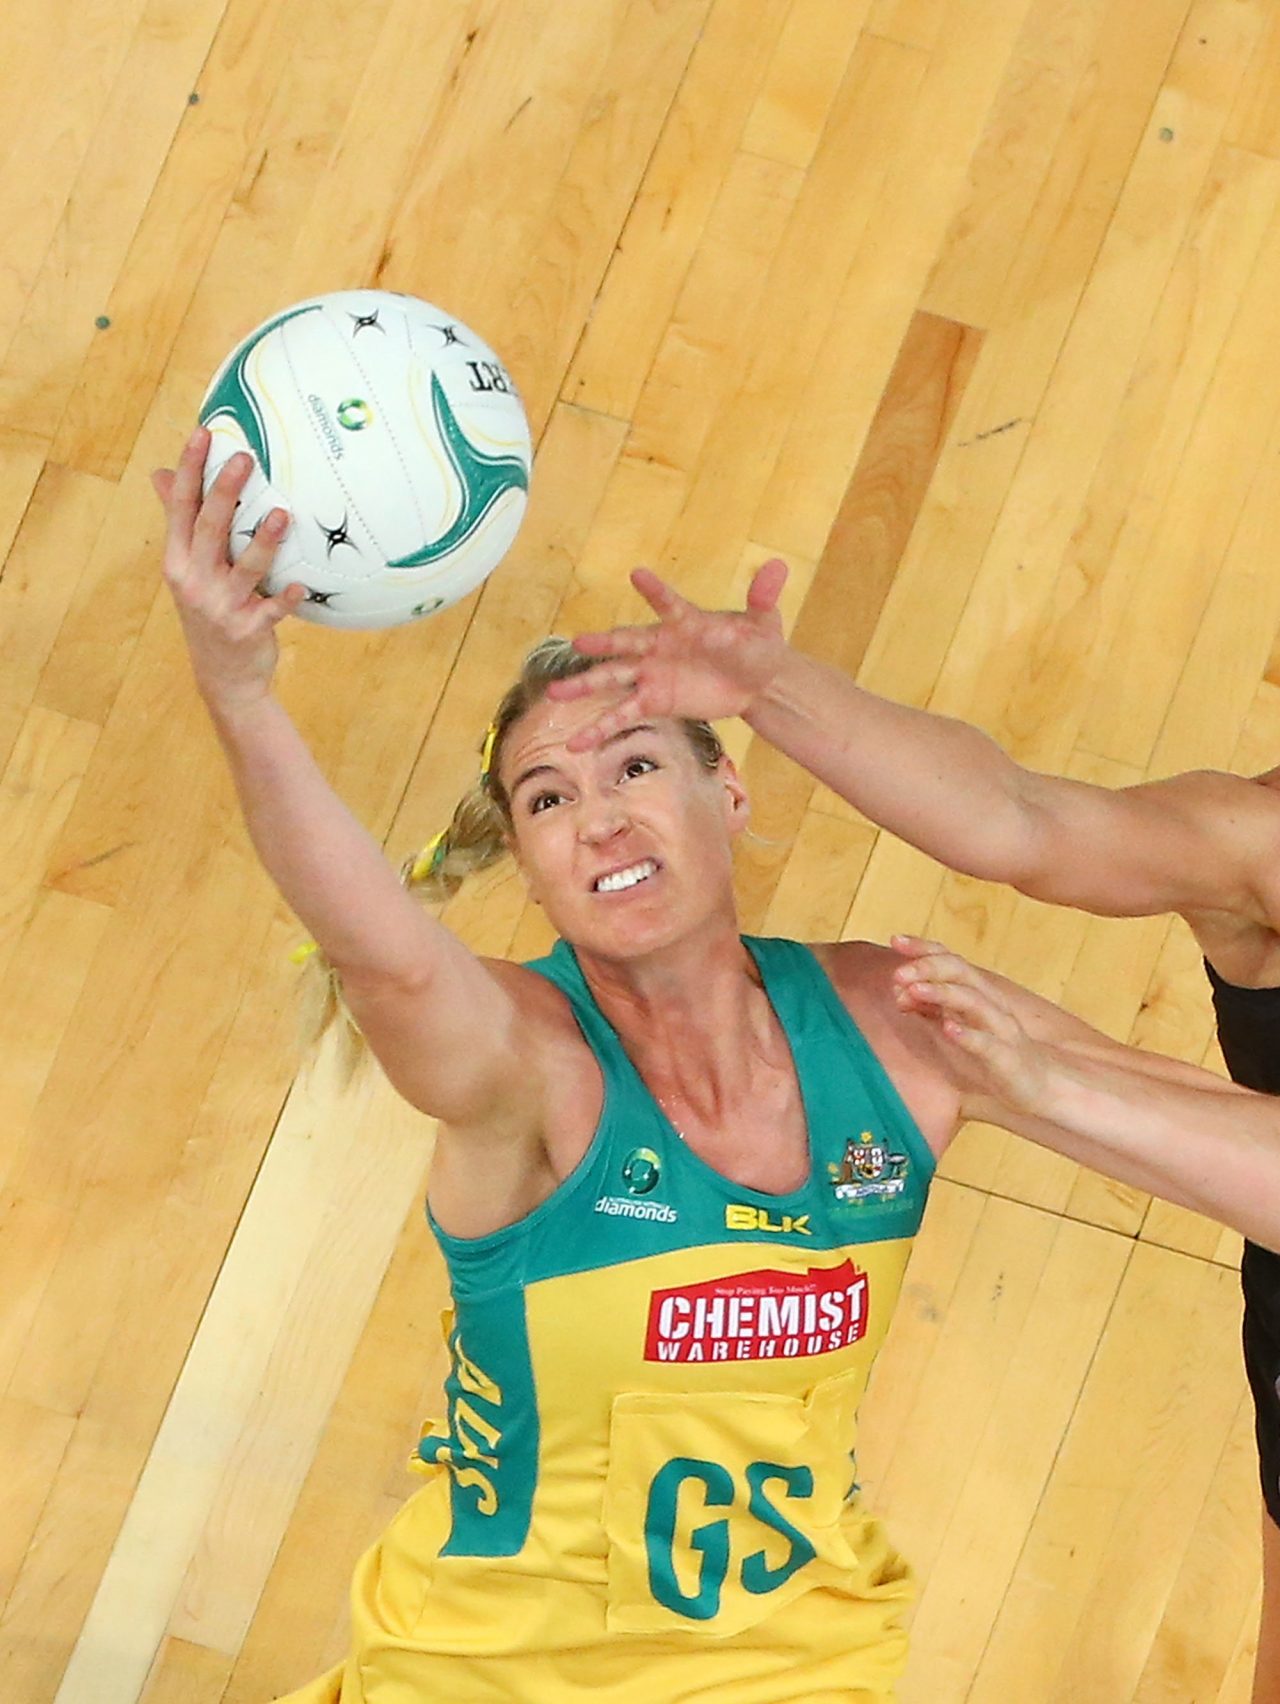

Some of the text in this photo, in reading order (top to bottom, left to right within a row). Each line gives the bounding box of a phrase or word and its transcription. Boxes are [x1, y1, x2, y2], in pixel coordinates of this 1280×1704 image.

[466, 361, 518, 398] RT
[307, 394, 344, 460] diamonds
[594, 1196, 678, 1223] diamonds
[725, 1204, 813, 1236] BLK
[658, 1279, 866, 1340] CHEMIST
[657, 1323, 860, 1361] WAREHOUSE
[645, 1456, 817, 1621] GS
